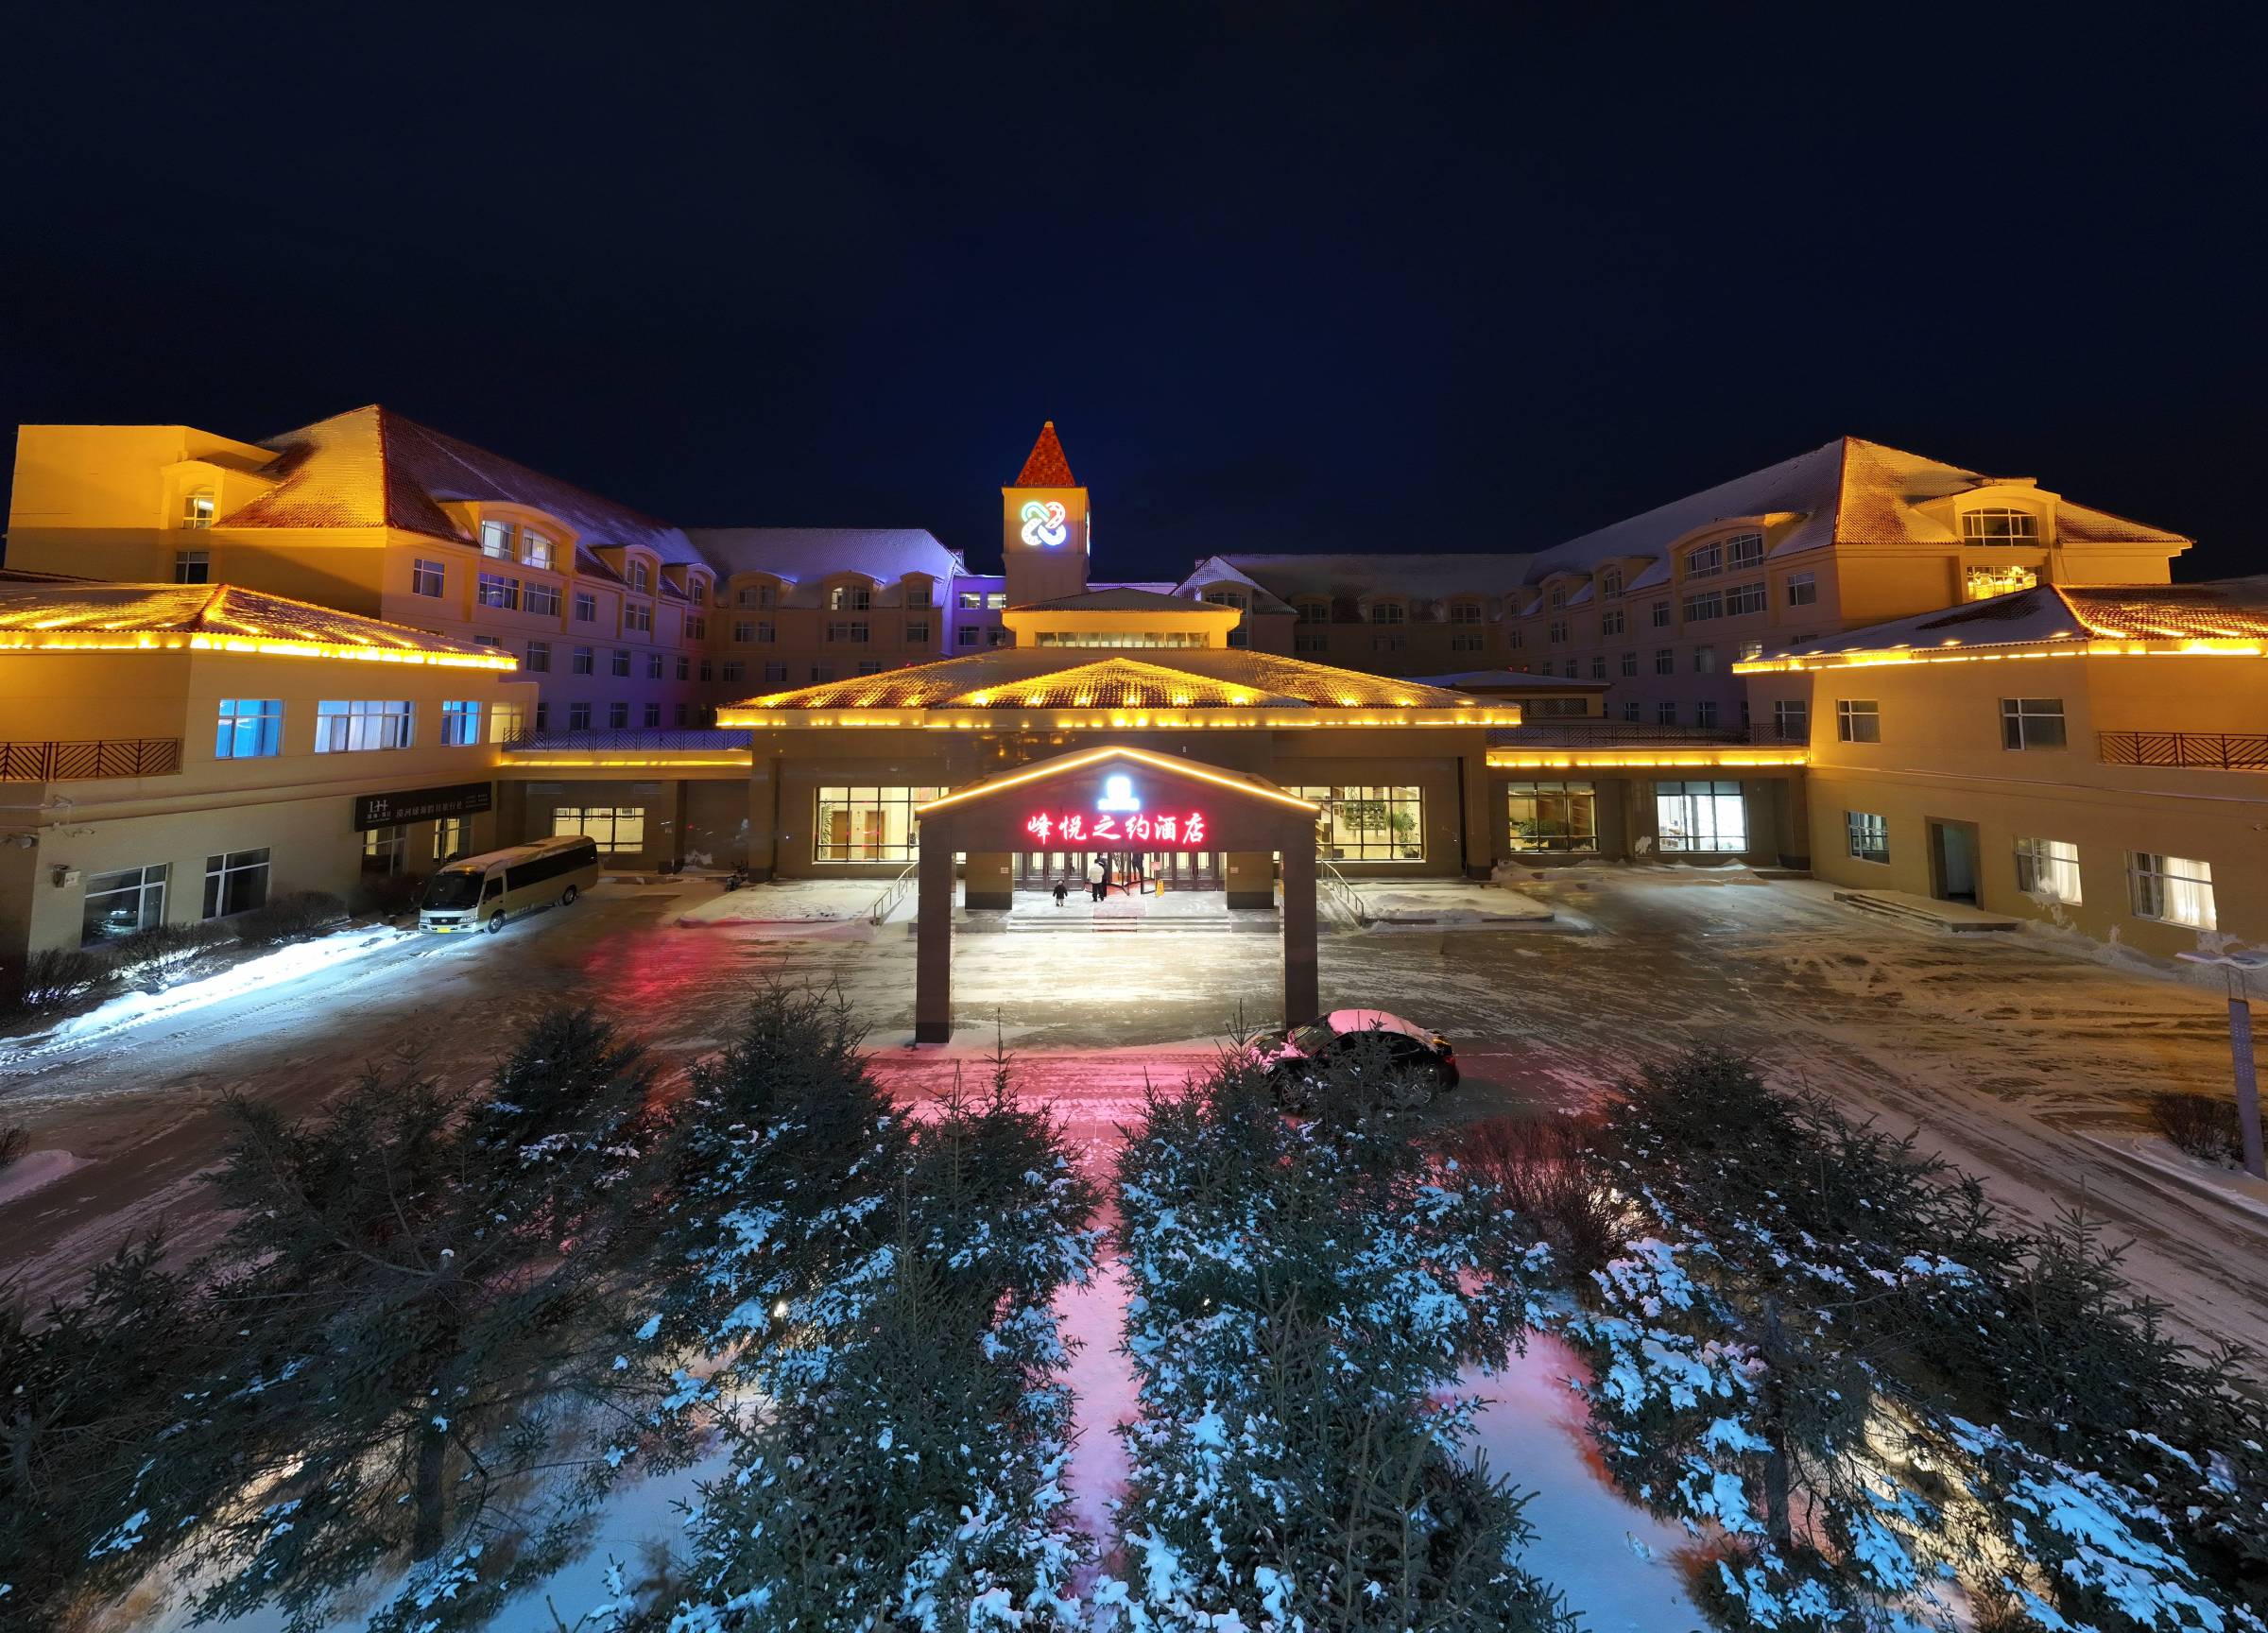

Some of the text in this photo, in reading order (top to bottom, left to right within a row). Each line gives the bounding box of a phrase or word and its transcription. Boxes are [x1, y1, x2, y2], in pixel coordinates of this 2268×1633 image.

[1027, 813, 1206, 845] 峰悦之约酒店
